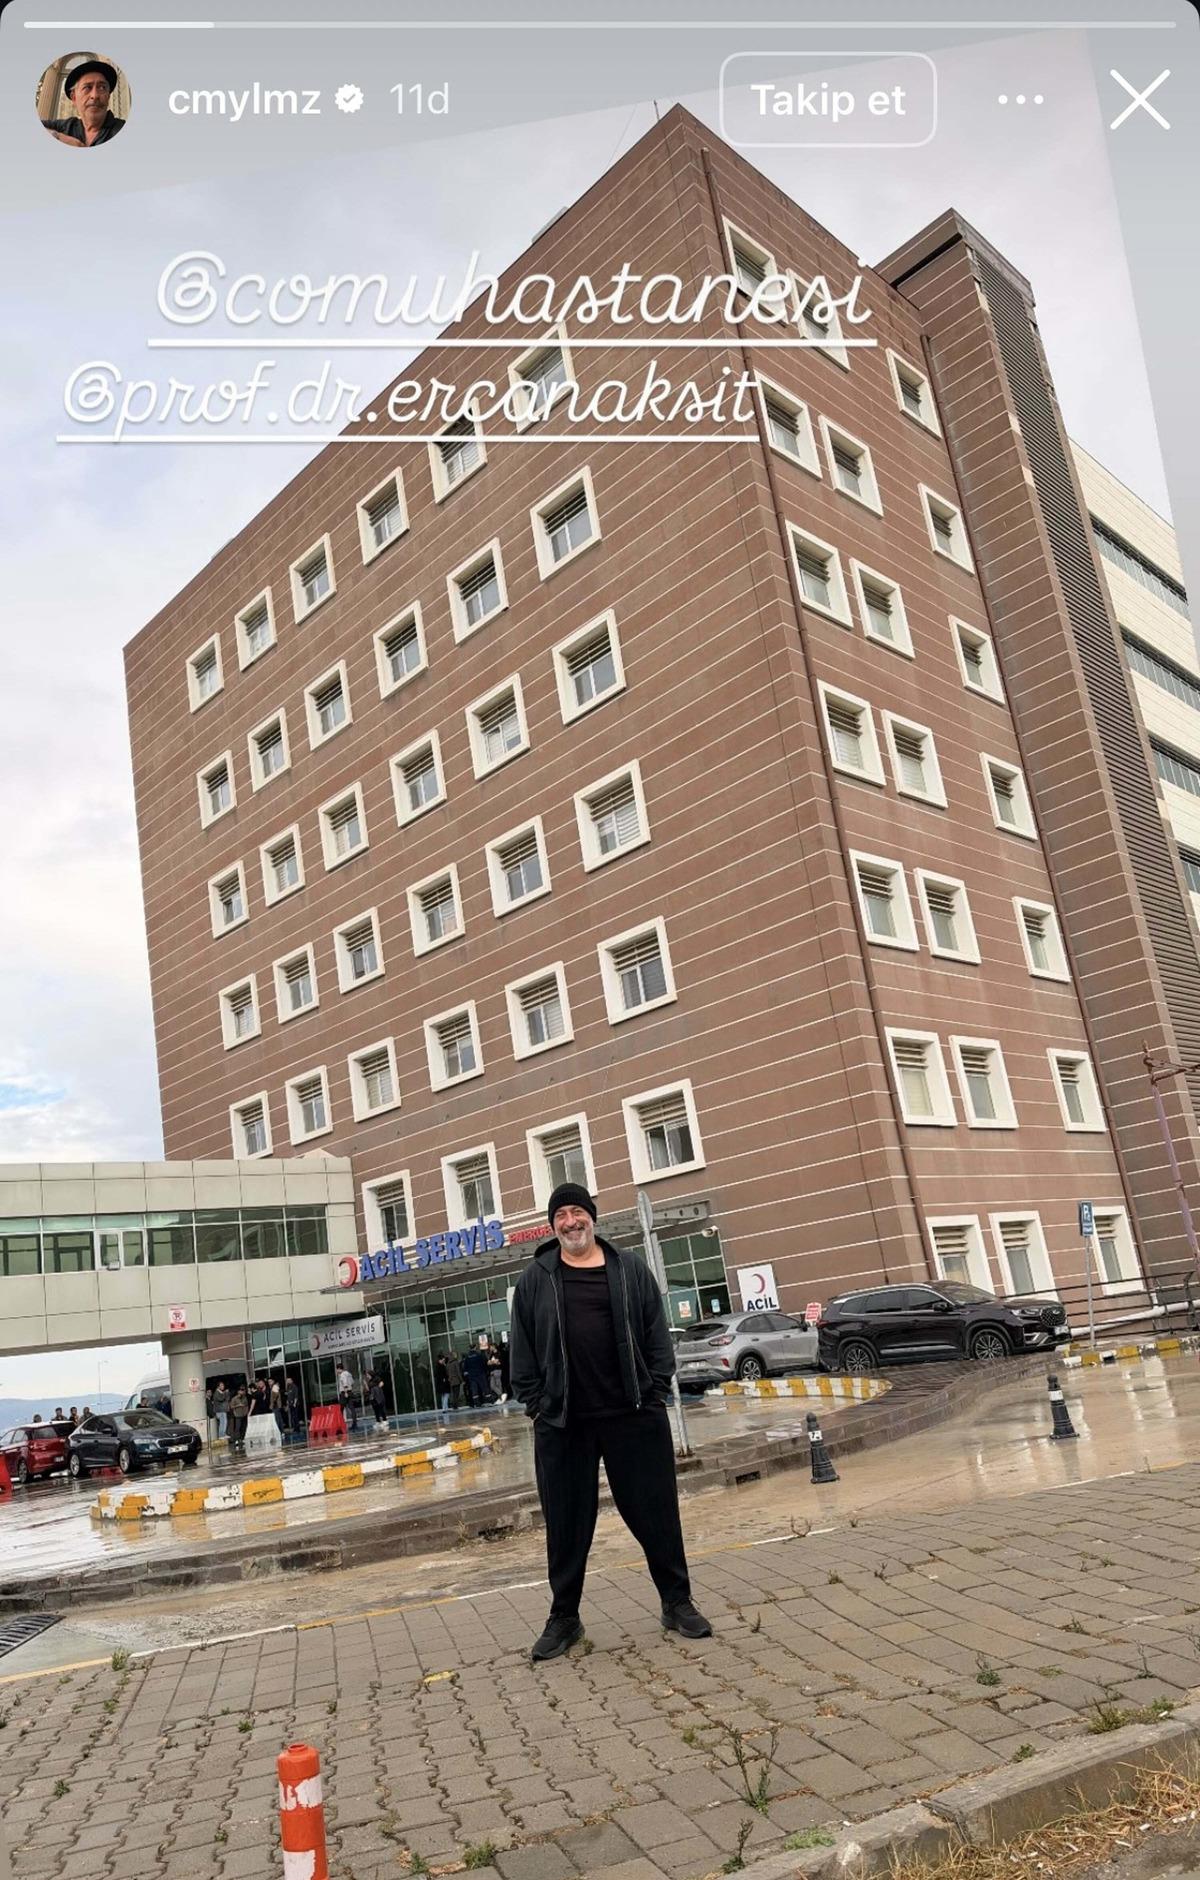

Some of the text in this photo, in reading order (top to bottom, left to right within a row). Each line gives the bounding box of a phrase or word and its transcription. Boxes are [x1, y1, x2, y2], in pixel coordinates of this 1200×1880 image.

[361, 1239, 410, 1281] ACİL
[416, 1216, 505, 1269] SERVİS
[747, 1294, 777, 1311] ACİL
